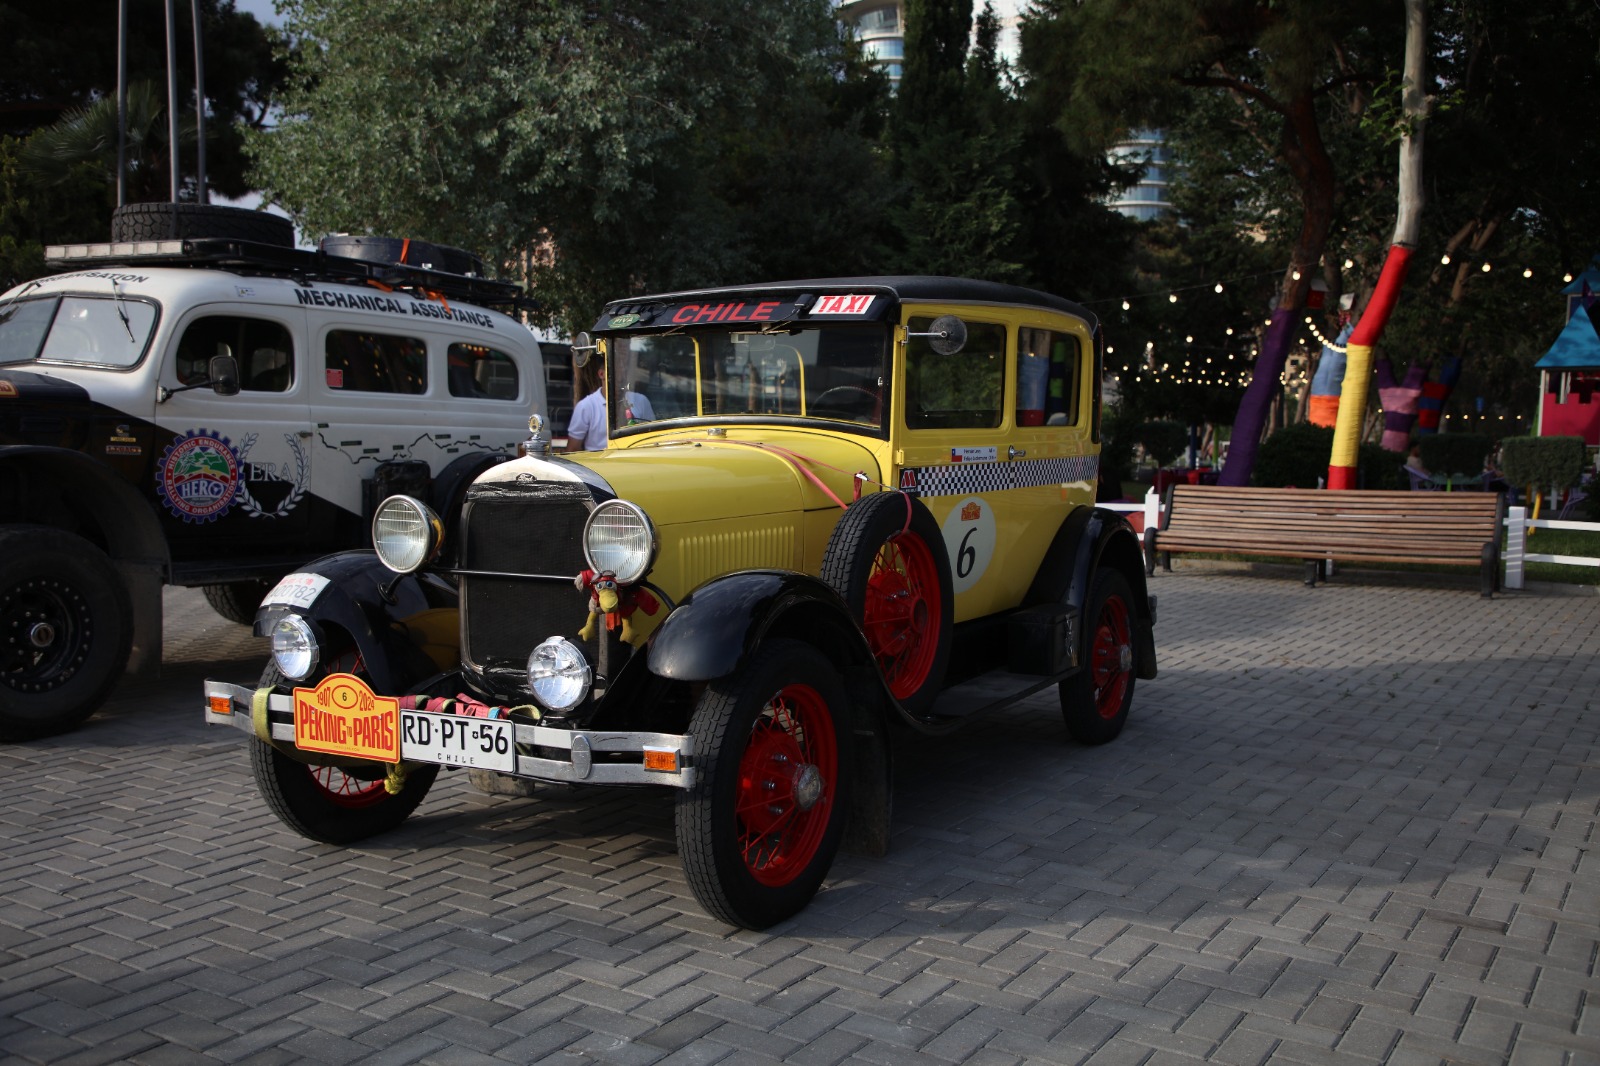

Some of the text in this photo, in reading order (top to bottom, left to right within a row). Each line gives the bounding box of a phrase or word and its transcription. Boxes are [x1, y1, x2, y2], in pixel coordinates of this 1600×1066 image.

[294, 289, 494, 328] MECHANICAL ASSISTANCE
[672, 301, 782, 323] CHILE
[817, 296, 870, 313] TAXI
[168, 439, 236, 469] HISTORIC ENDURANCE
[249, 462, 293, 482] ERA
[167, 479, 237, 514] RALLYING ORGANISATION
[182, 479, 224, 498] HERO
[956, 527, 977, 579] 6
[317, 686, 331, 708] 1907
[342, 692, 347, 702] 6
[358, 690, 375, 712] 2024
[299, 699, 347, 745] PEKING
[353, 711, 394, 752] PARIS
[437, 752, 475, 765] CHILE
